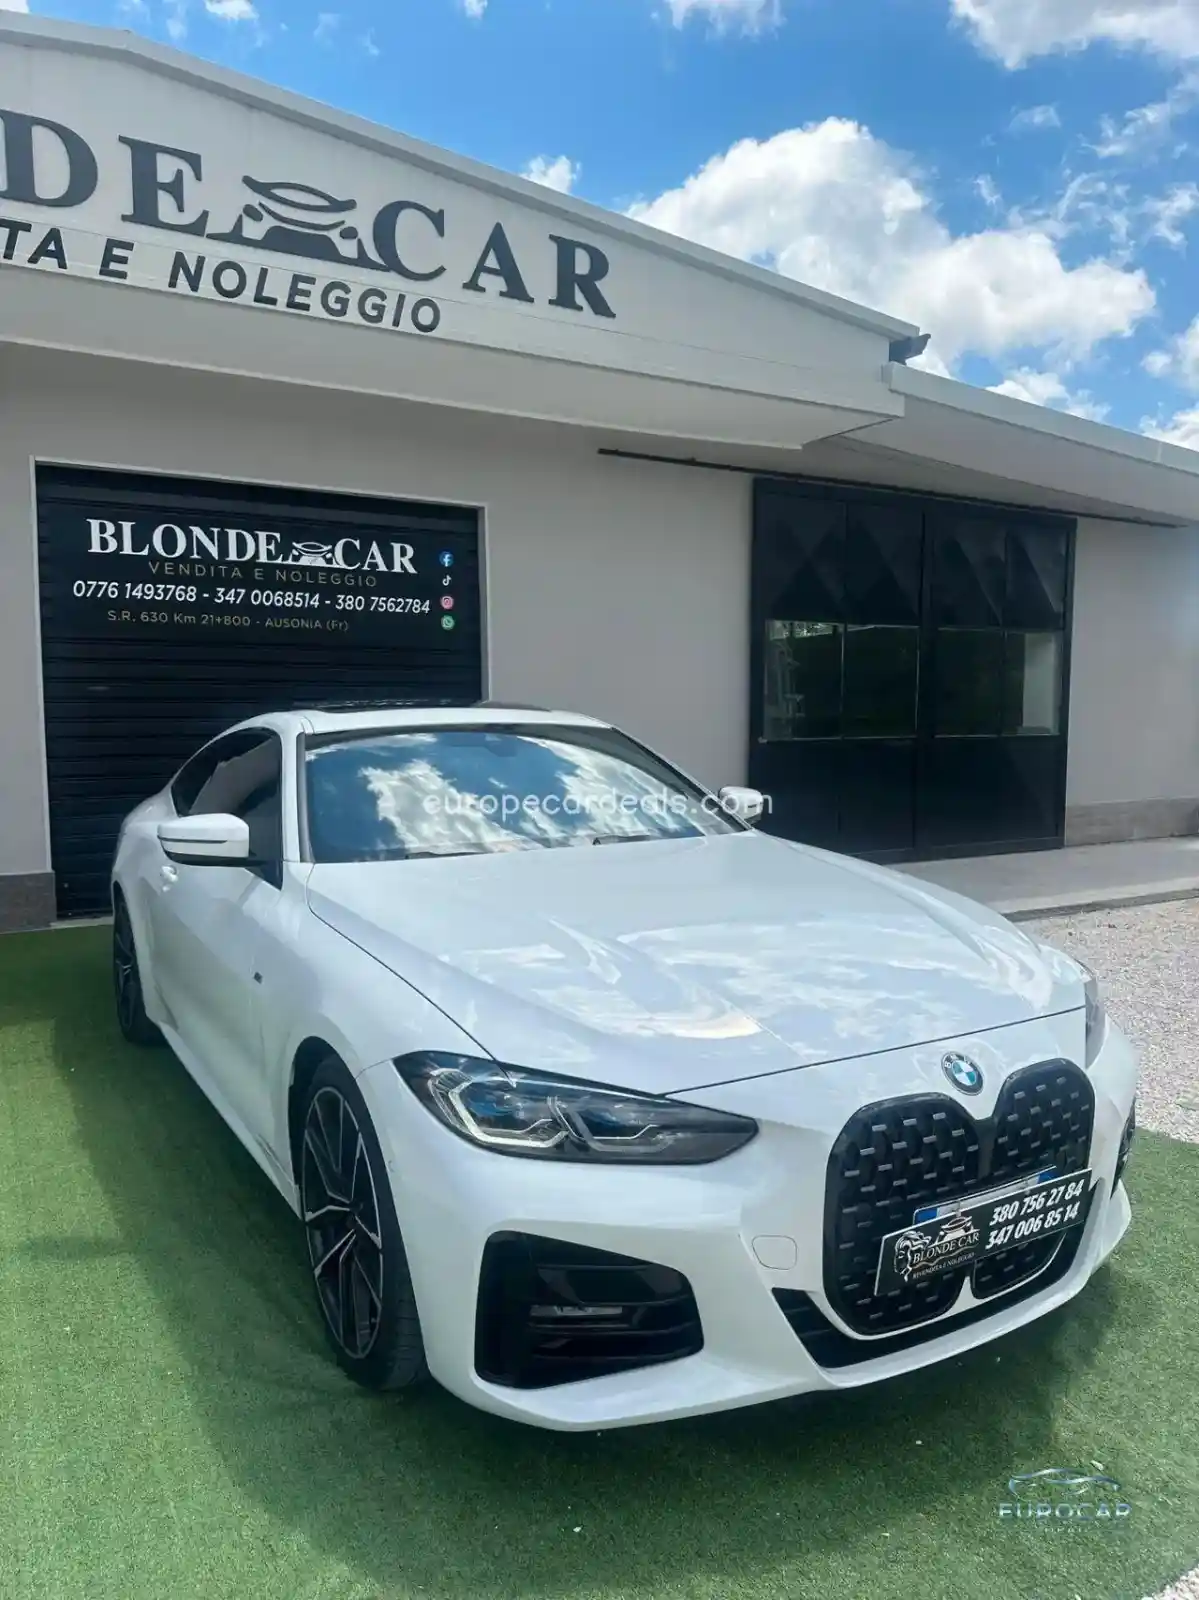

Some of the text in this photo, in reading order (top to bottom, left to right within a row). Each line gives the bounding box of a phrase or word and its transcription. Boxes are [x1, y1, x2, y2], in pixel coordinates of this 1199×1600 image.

[0, 109, 616, 318] DE CAR
[0, 218, 441, 333] TA E NOLEGGIO
[86, 518, 418, 574] BLONDE CAR
[73, 580, 119, 599] 0776
[125, 582, 197, 602] 1493768
[214, 587, 246, 605] 347
[250, 590, 320, 609] 0068514
[335, 594, 365, 611] 380
[370, 596, 431, 614] 7562784
[148, 561, 377, 587] VENDITA E NOLEGGIO
[140, 612, 168, 623] 630
[174, 613, 196, 625] Km
[201, 614, 250, 626] 21+800
[265, 617, 323, 630] AUSONIA
[326, 620, 349, 632] (Fr)
[985, 1201, 1081, 1250] 347 006 85 14
[989, 1179, 1085, 1226] 380 756 27 84
[913, 1231, 980, 1264] BLONDE CAR
